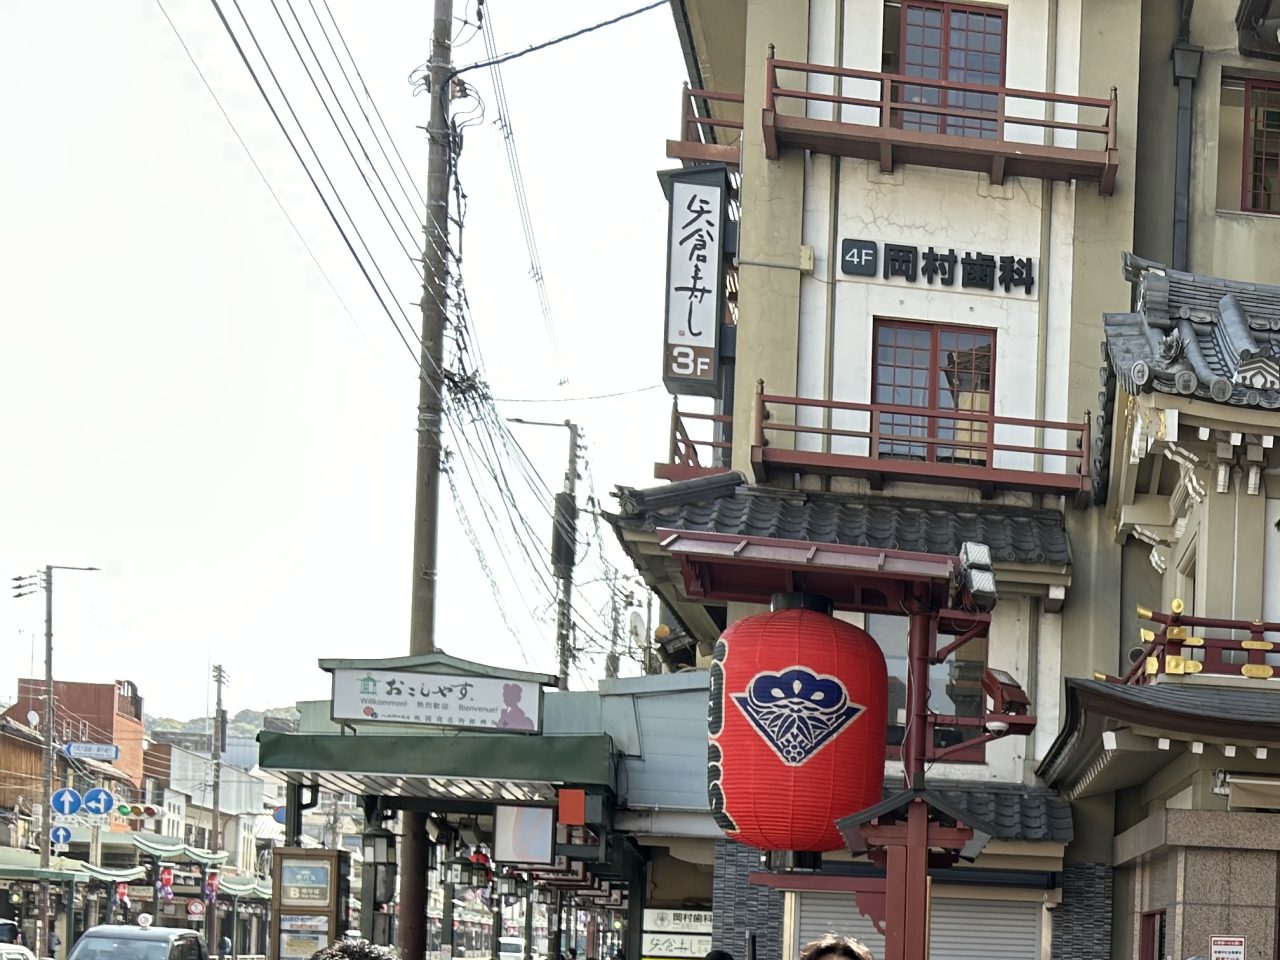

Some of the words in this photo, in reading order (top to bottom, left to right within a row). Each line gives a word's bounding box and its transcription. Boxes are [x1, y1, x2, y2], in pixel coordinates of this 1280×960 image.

[844, 247, 874, 265] 4F
[883, 242, 1035, 295] 岡村歯科
[671, 345, 710, 376] 3F
[360, 697, 408, 708] Willkommen!
[458, 703, 498, 714] Bienvenue!
[672, 912, 713, 923] 岡村歯科
